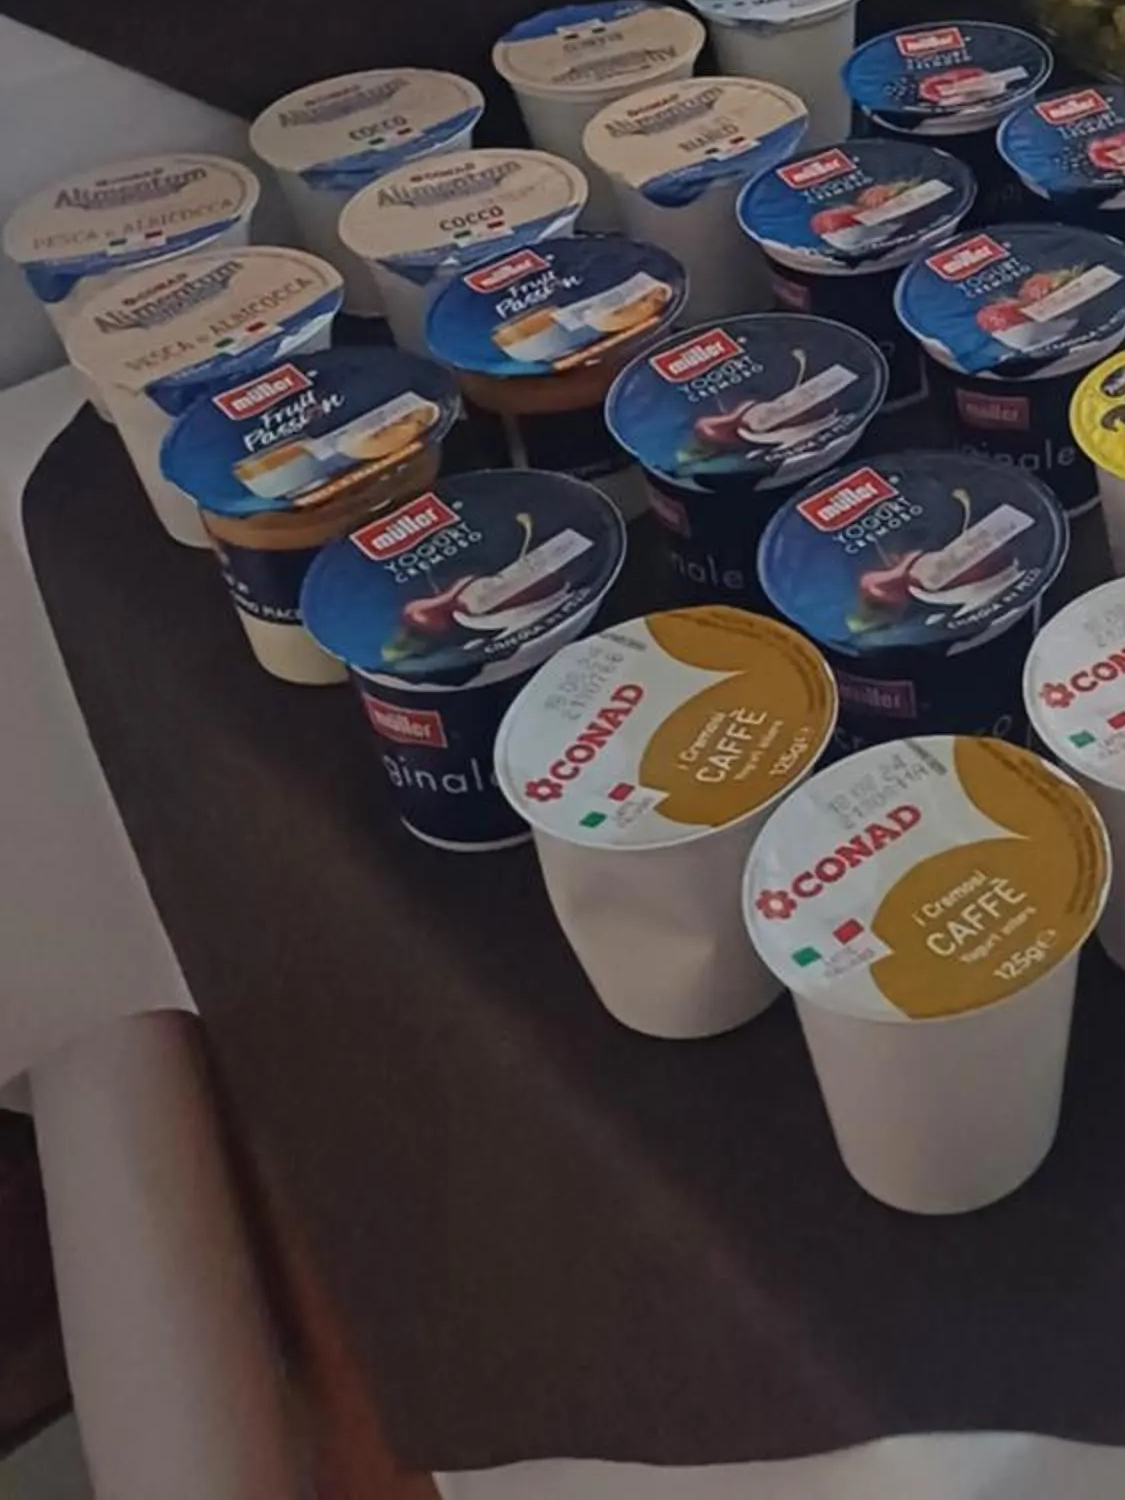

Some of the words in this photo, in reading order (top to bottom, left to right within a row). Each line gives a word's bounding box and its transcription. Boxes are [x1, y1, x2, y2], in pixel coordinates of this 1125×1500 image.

[348, 115, 410, 142] COCCO
[438, 204, 506, 233] COCCO
[494, 274, 584, 319] Passin
[230, 374, 296, 413] müller
[677, 355, 755, 394] YOGURT
[686, 362, 764, 403] CREMOSO
[243, 391, 346, 453] Passin
[816, 482, 879, 522] müller
[833, 494, 910, 544] YOGURT
[371, 507, 439, 551] müller
[384, 522, 473, 573] YOGURT
[844, 504, 924, 555] CREMOSO
[394, 530, 483, 584] CREMOSO
[372, 707, 433, 741] müller
[550, 682, 645, 783] CONAD
[695, 706, 768, 784] CAFFÈ
[383, 754, 497, 794] ginal
[791, 803, 922, 900] CONAD
[920, 870, 987, 920] Cremosi
[926, 877, 1029, 957] CAFFÈ
